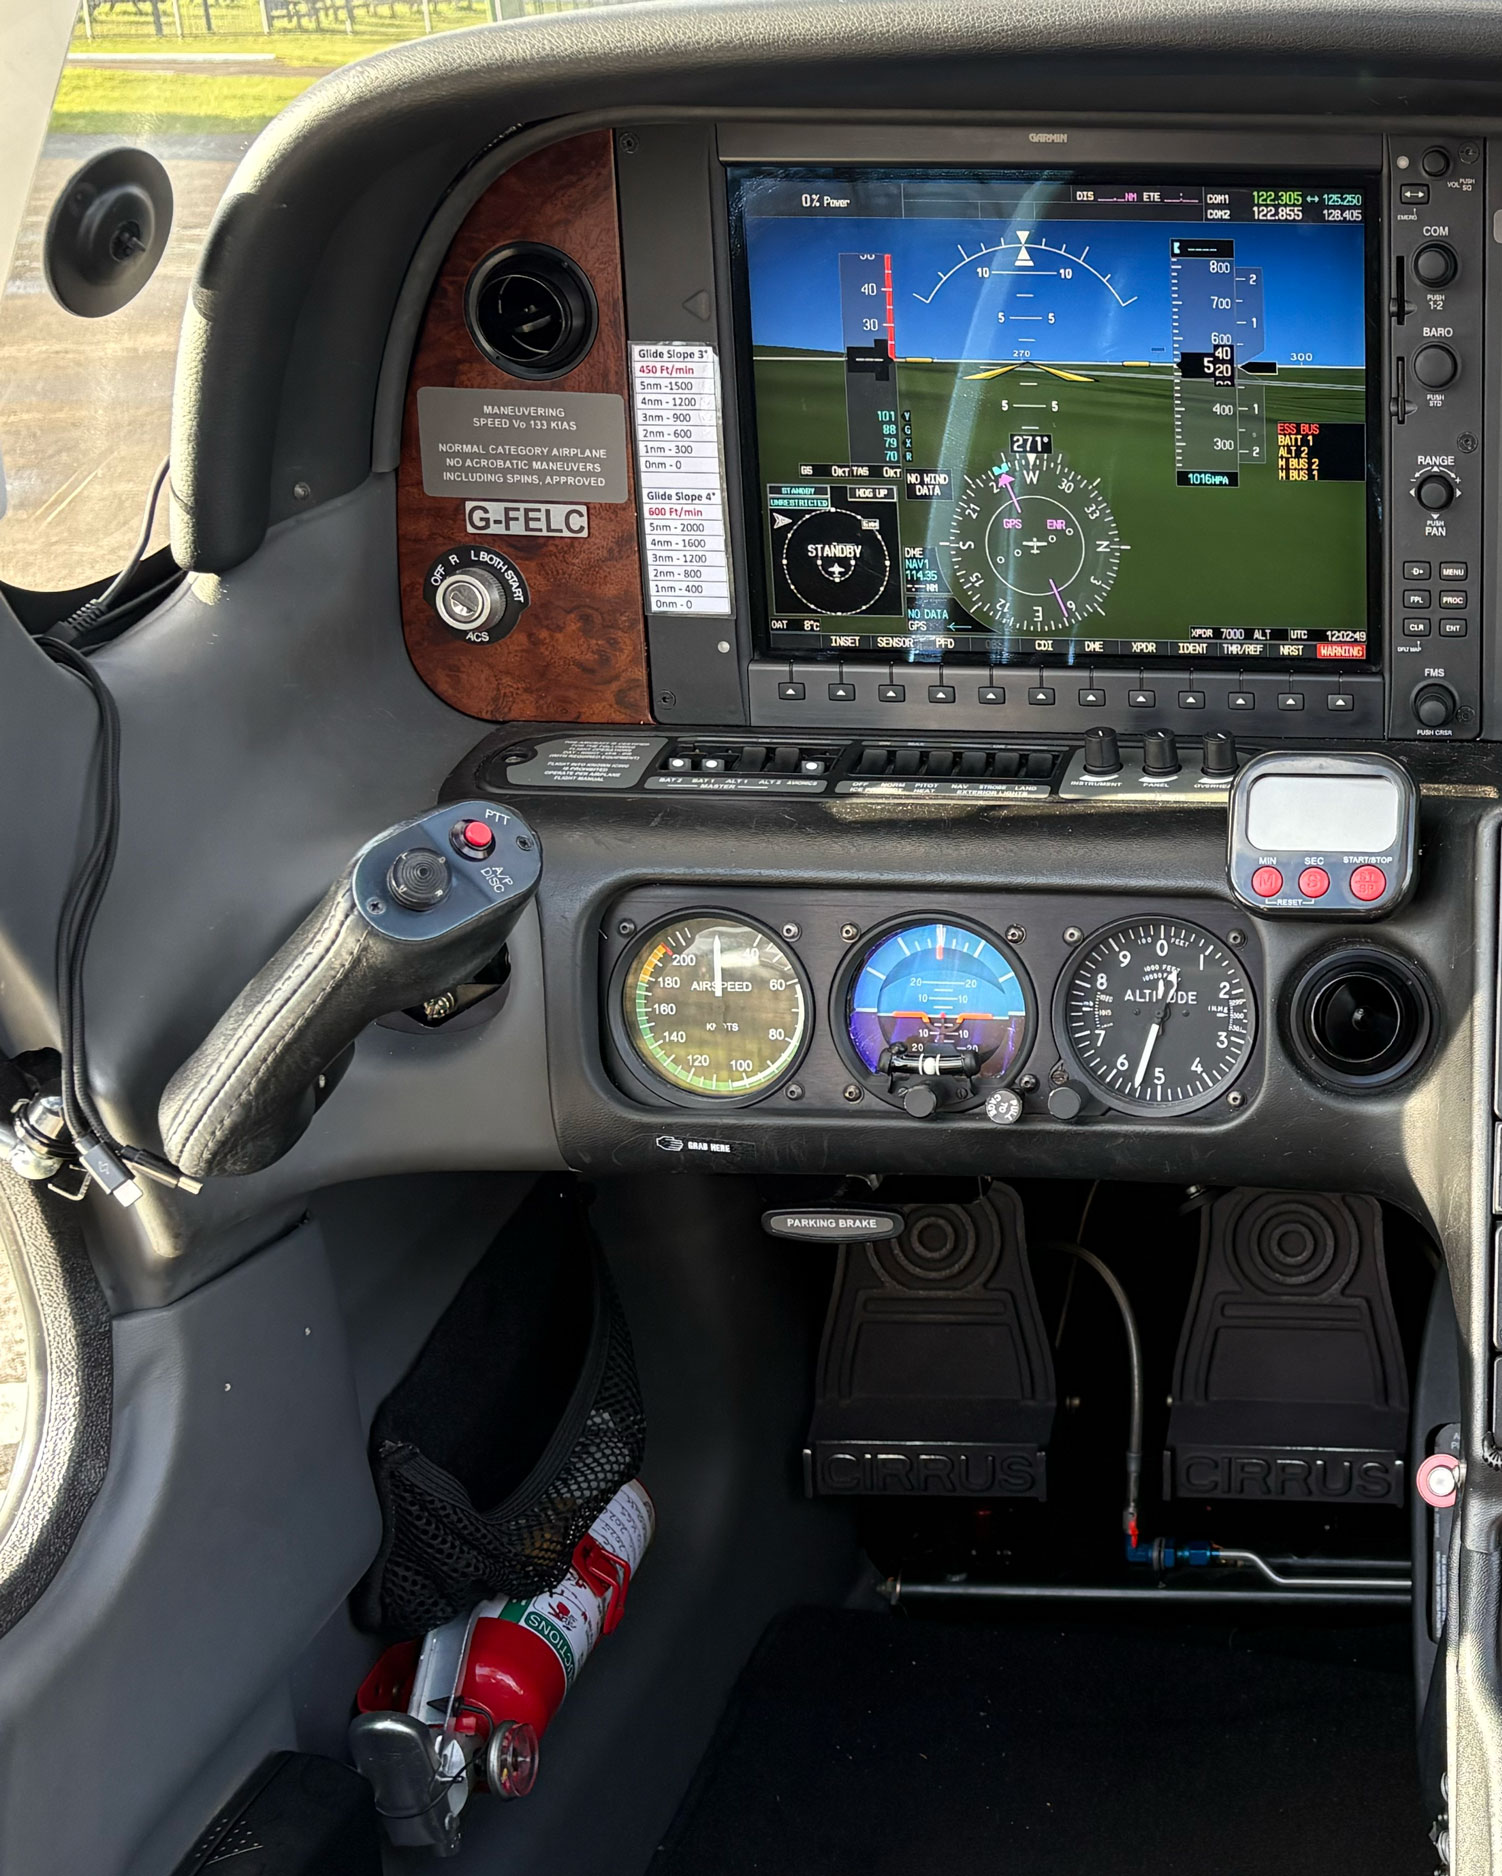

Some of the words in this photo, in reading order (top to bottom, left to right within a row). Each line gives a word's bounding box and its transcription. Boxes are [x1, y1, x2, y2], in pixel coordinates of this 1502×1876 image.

[1029, 133, 1068, 143] GARMIN
[802, 194, 820, 207] 0%
[1253, 191, 1302, 205] 122.305
[1323, 194, 1361, 206] 125.250
[1253, 207, 1302, 220] 122.855
[1323, 209, 1361, 221] 128.405
[1423, 226, 1448, 236] COM
[1209, 261, 1230, 274] 800
[1423, 327, 1453, 337] BARO
[638, 349, 663, 360] Glide
[664, 349, 695, 362] Slope
[639, 365, 658, 376] 450
[660, 364, 694, 376] Ft/min
[640, 381, 662, 391] 5nm
[664, 381, 693, 391] -1500
[641, 397, 663, 407] 4nm
[672, 397, 697, 407] 1200
[483, 405, 565, 417] MANEUVERING
[641, 413, 664, 423] 3nm
[672, 413, 691, 423] 900
[473, 418, 510, 429] SPEED
[530, 420, 547, 429] 133
[550, 420, 577, 430] KIAS
[1278, 424, 1297, 434] ESS
[1300, 424, 1319, 434] BUS
[642, 428, 665, 439] 2nm
[673, 428, 692, 439] 600
[1012, 437, 1049, 451] 271°
[1278, 435, 1302, 446] BATT
[1307, 435, 1313, 446] 1
[438, 443, 486, 454] NORMAL
[489, 445, 549, 457] CATEGORY
[552, 448, 607, 458] AIRPLANE
[644, 444, 665, 455] 1nm
[674, 444, 693, 455] 300
[1279, 447, 1297, 457] ALT
[1300, 447, 1308, 457] 2
[446, 458, 463, 467] NO
[465, 459, 529, 470] ACROBATIC
[532, 461, 601, 472] MANEUVERS
[644, 460, 667, 470] 0nm
[675, 460, 682, 470] 0
[1418, 456, 1455, 465] RANGE
[443, 472, 504, 483] INCLUDING
[506, 474, 543, 485] SPINS,
[545, 475, 606, 487] APPROVED
[647, 491, 671, 502] Glide
[673, 491, 703, 504] Slope
[648, 507, 667, 517] 600
[669, 507, 703, 519] Ft/min
[468, 505, 586, 534] G-FELC
[808, 544, 861, 557] STANDBY
[430, 564, 446, 586] OFF
[503, 569, 524, 602] START
[466, 631, 490, 642] ACS
[830, 636, 860, 647] INSET
[1326, 631, 1366, 641] 12:02:49
[877, 637, 914, 648] SENSOR
[936, 638, 954, 649] PFD
[1035, 640, 1053, 651] CDI
[1178, 644, 1207, 654] IDENT
[1280, 646, 1303, 656] NRST
[1321, 646, 1362, 656] WARNING
[484, 809, 510, 825] PTT
[1304, 857, 1324, 865] SEC
[1343, 856, 1392, 864] START/STOP
[480, 867, 504, 893] DISC
[492, 866, 514, 886] A/P
[658, 977, 680, 989] 180
[691, 981, 752, 992] AIRSPEED
[654, 1004, 675, 1016] 160
[687, 1055, 709, 1066] 120
[688, 1142, 708, 1151] GRAB
[710, 1143, 731, 1152] HERE
[787, 1219, 836, 1227] PARKING
[839, 1220, 877, 1228] BRAKE
[822, 1454, 1035, 1493] CIRRUS
